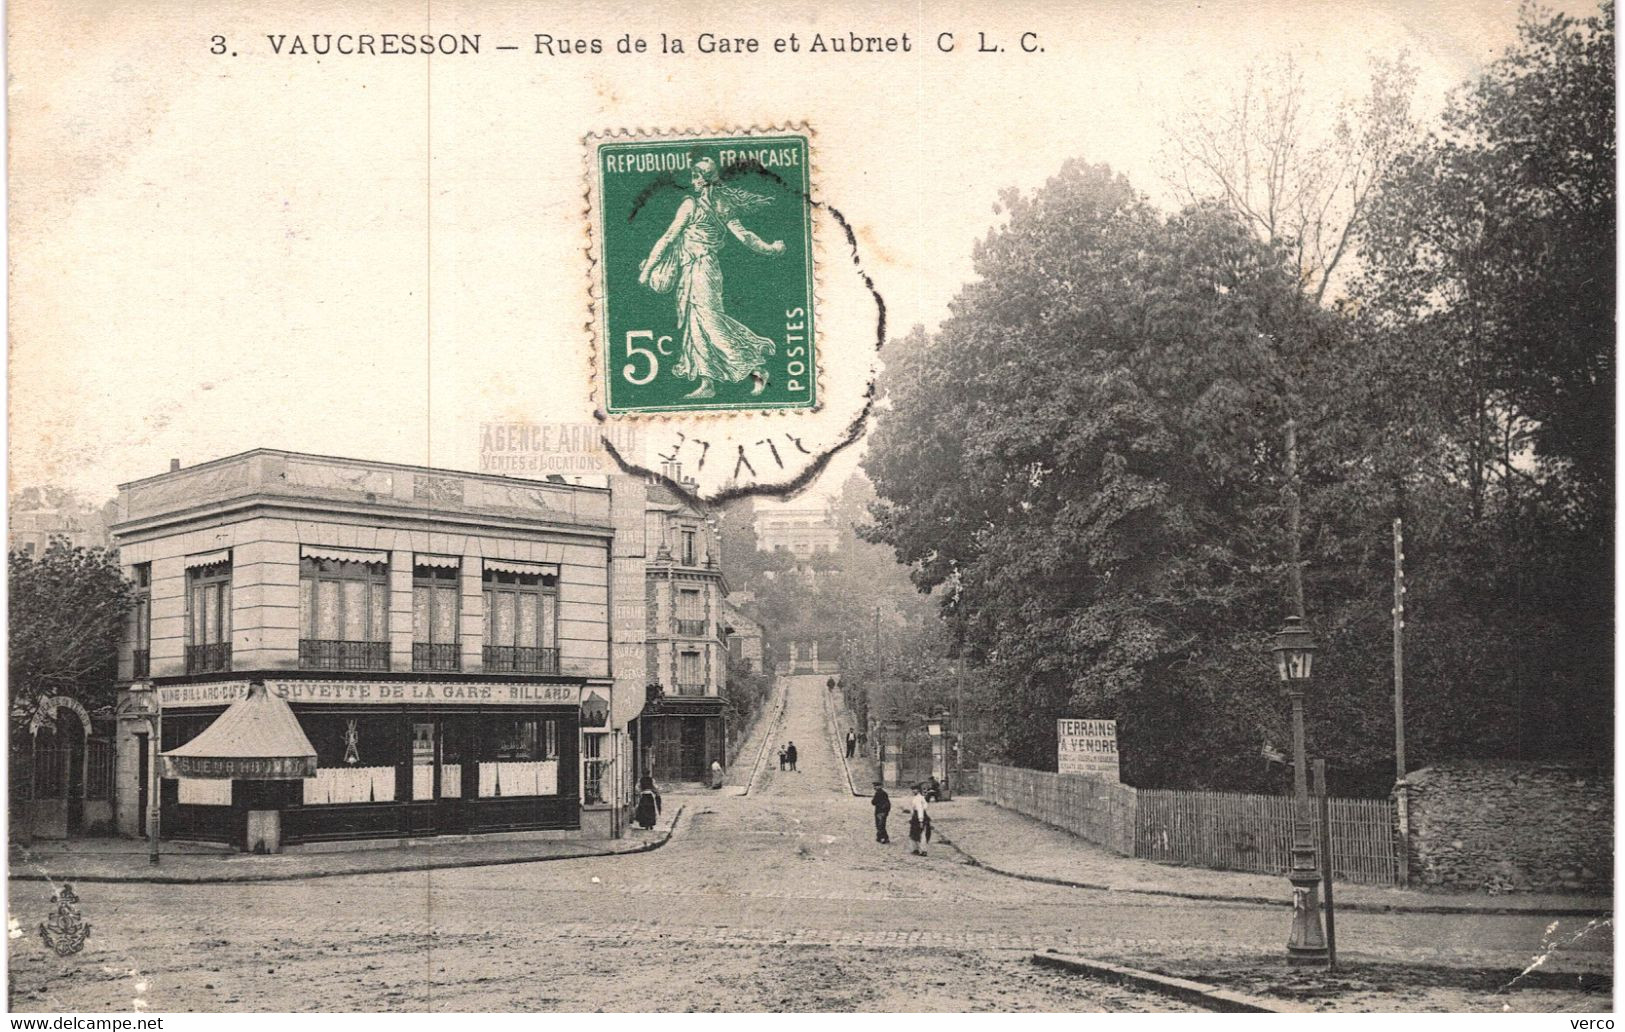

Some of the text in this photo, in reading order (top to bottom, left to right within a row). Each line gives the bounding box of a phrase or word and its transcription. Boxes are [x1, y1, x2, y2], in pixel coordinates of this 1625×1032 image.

[787, 306, 805, 393] POSTES
[481, 424, 551, 452] AGENCE
[482, 454, 526, 470] VENTES
[539, 454, 603, 471] LOCATIONS
[277, 683, 571, 700] BUVETTE DE LA GARE BILLARD
[1060, 720, 1115, 736] TERRAINS
[1071, 739, 1117, 754] VENDRE
